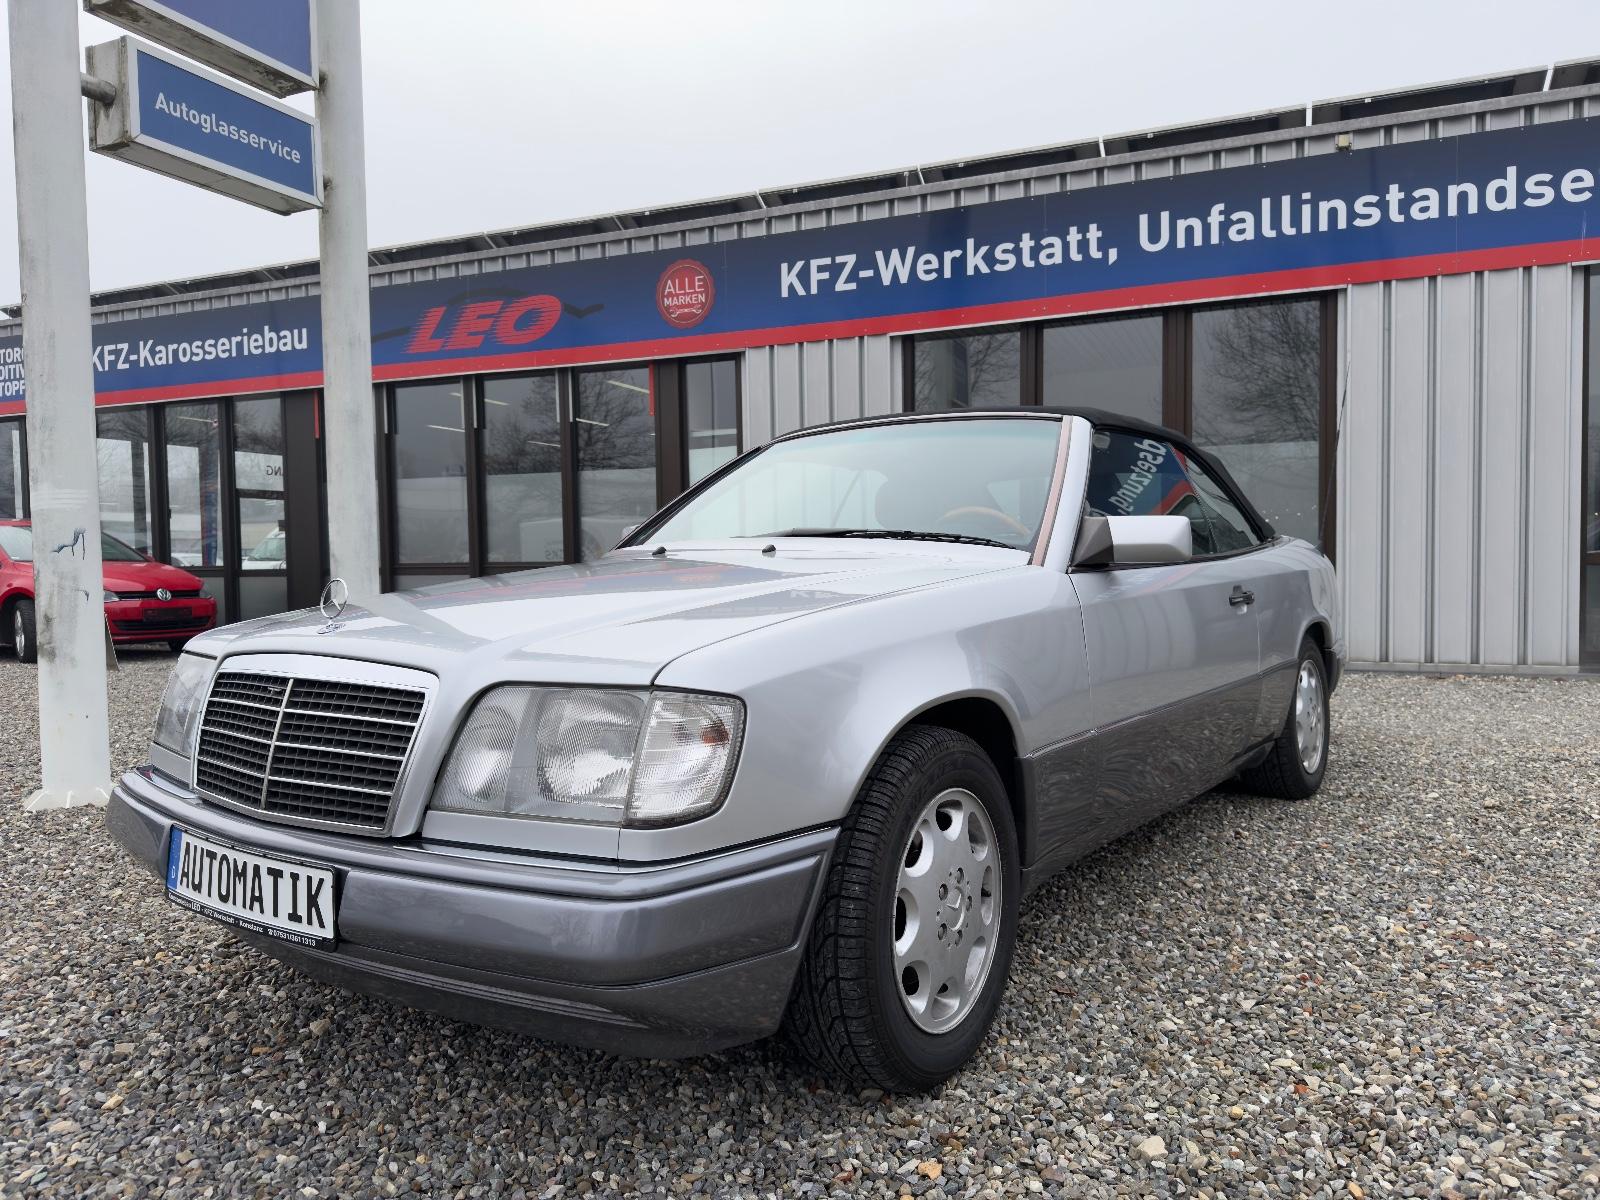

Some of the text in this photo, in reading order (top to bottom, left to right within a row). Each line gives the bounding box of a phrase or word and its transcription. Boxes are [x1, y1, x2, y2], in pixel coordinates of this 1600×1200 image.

[155, 92, 301, 164] Autoglasservice
[664, 276, 705, 296] ALLE
[780, 223, 1117, 298] KFZ-Werkstatt,
[403, 294, 561, 353] LEO
[664, 293, 706, 307] MARKEN
[92, 325, 308, 372] KFZ-Karosseriebau
[179, 841, 326, 929] AUTOMATIK
[191, 901, 201, 912] LEO
